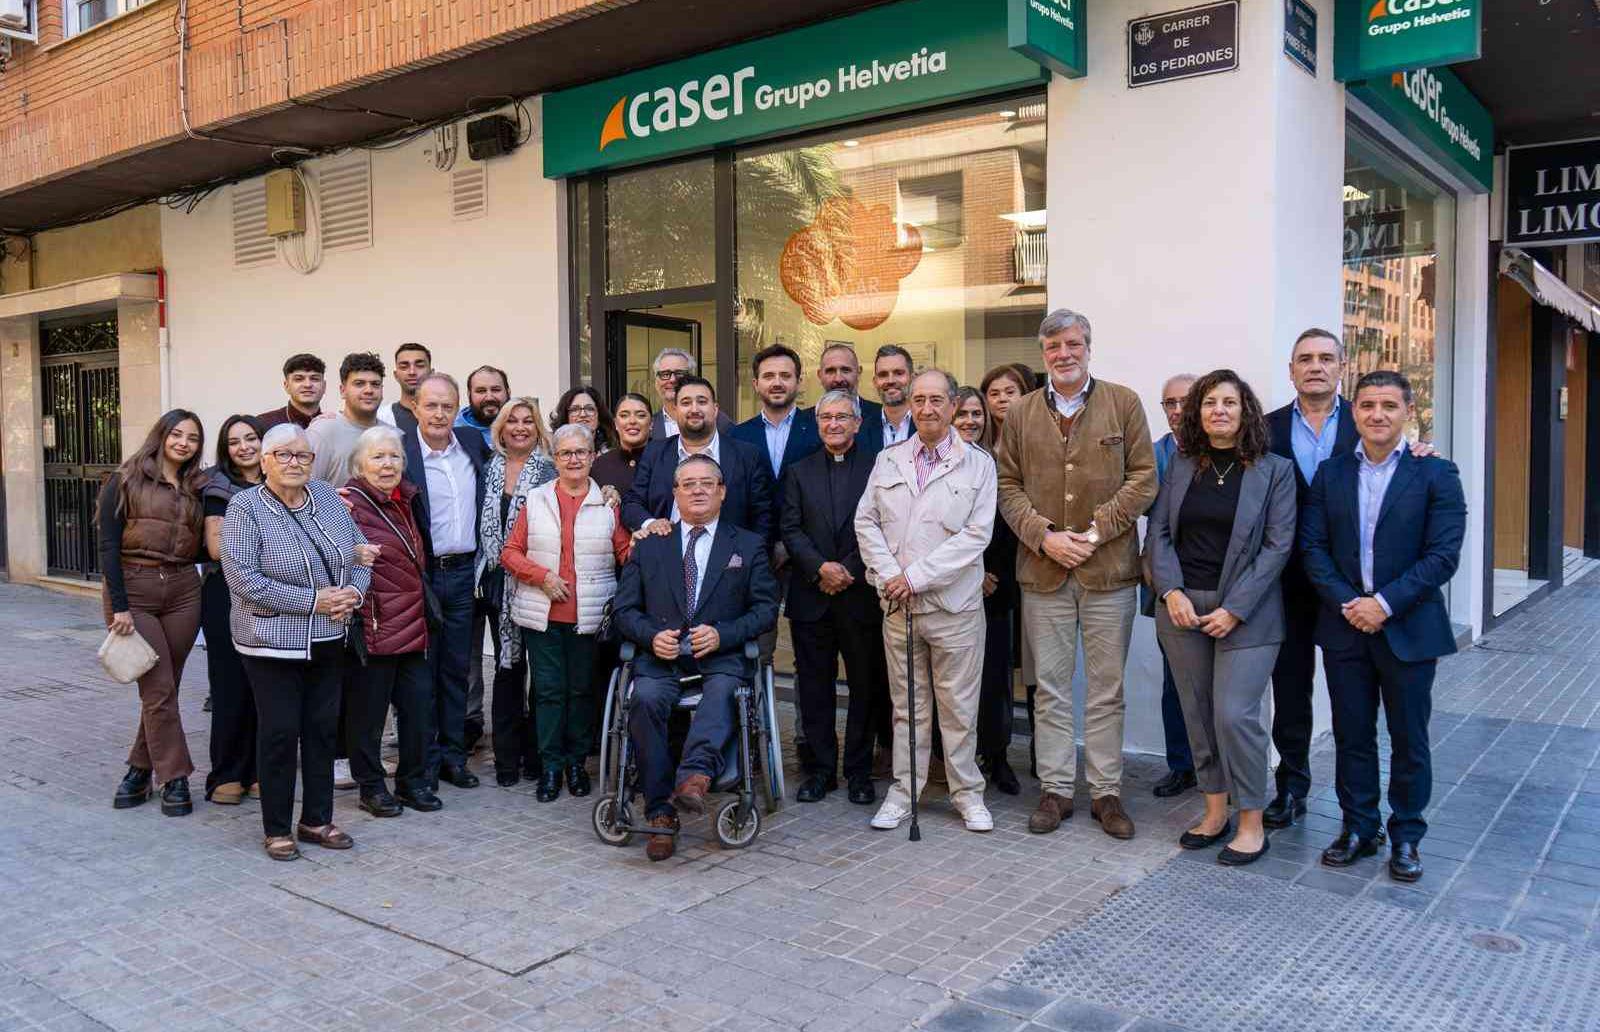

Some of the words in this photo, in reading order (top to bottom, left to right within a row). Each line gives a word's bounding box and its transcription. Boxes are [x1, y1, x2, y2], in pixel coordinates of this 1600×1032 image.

[1162, 15, 1210, 34] CARRER
[1368, 20, 1411, 36] Grupo
[1413, 7, 1471, 28] Helvetia
[1173, 36, 1191, 49] DE
[1132, 62, 1157, 77] LOS
[1161, 47, 1233, 71] PEDRONES
[628, 66, 755, 138] caser
[755, 84, 832, 110] Grupo
[838, 47, 947, 93] Helvetia
[1534, 163, 1600, 196] LIM
